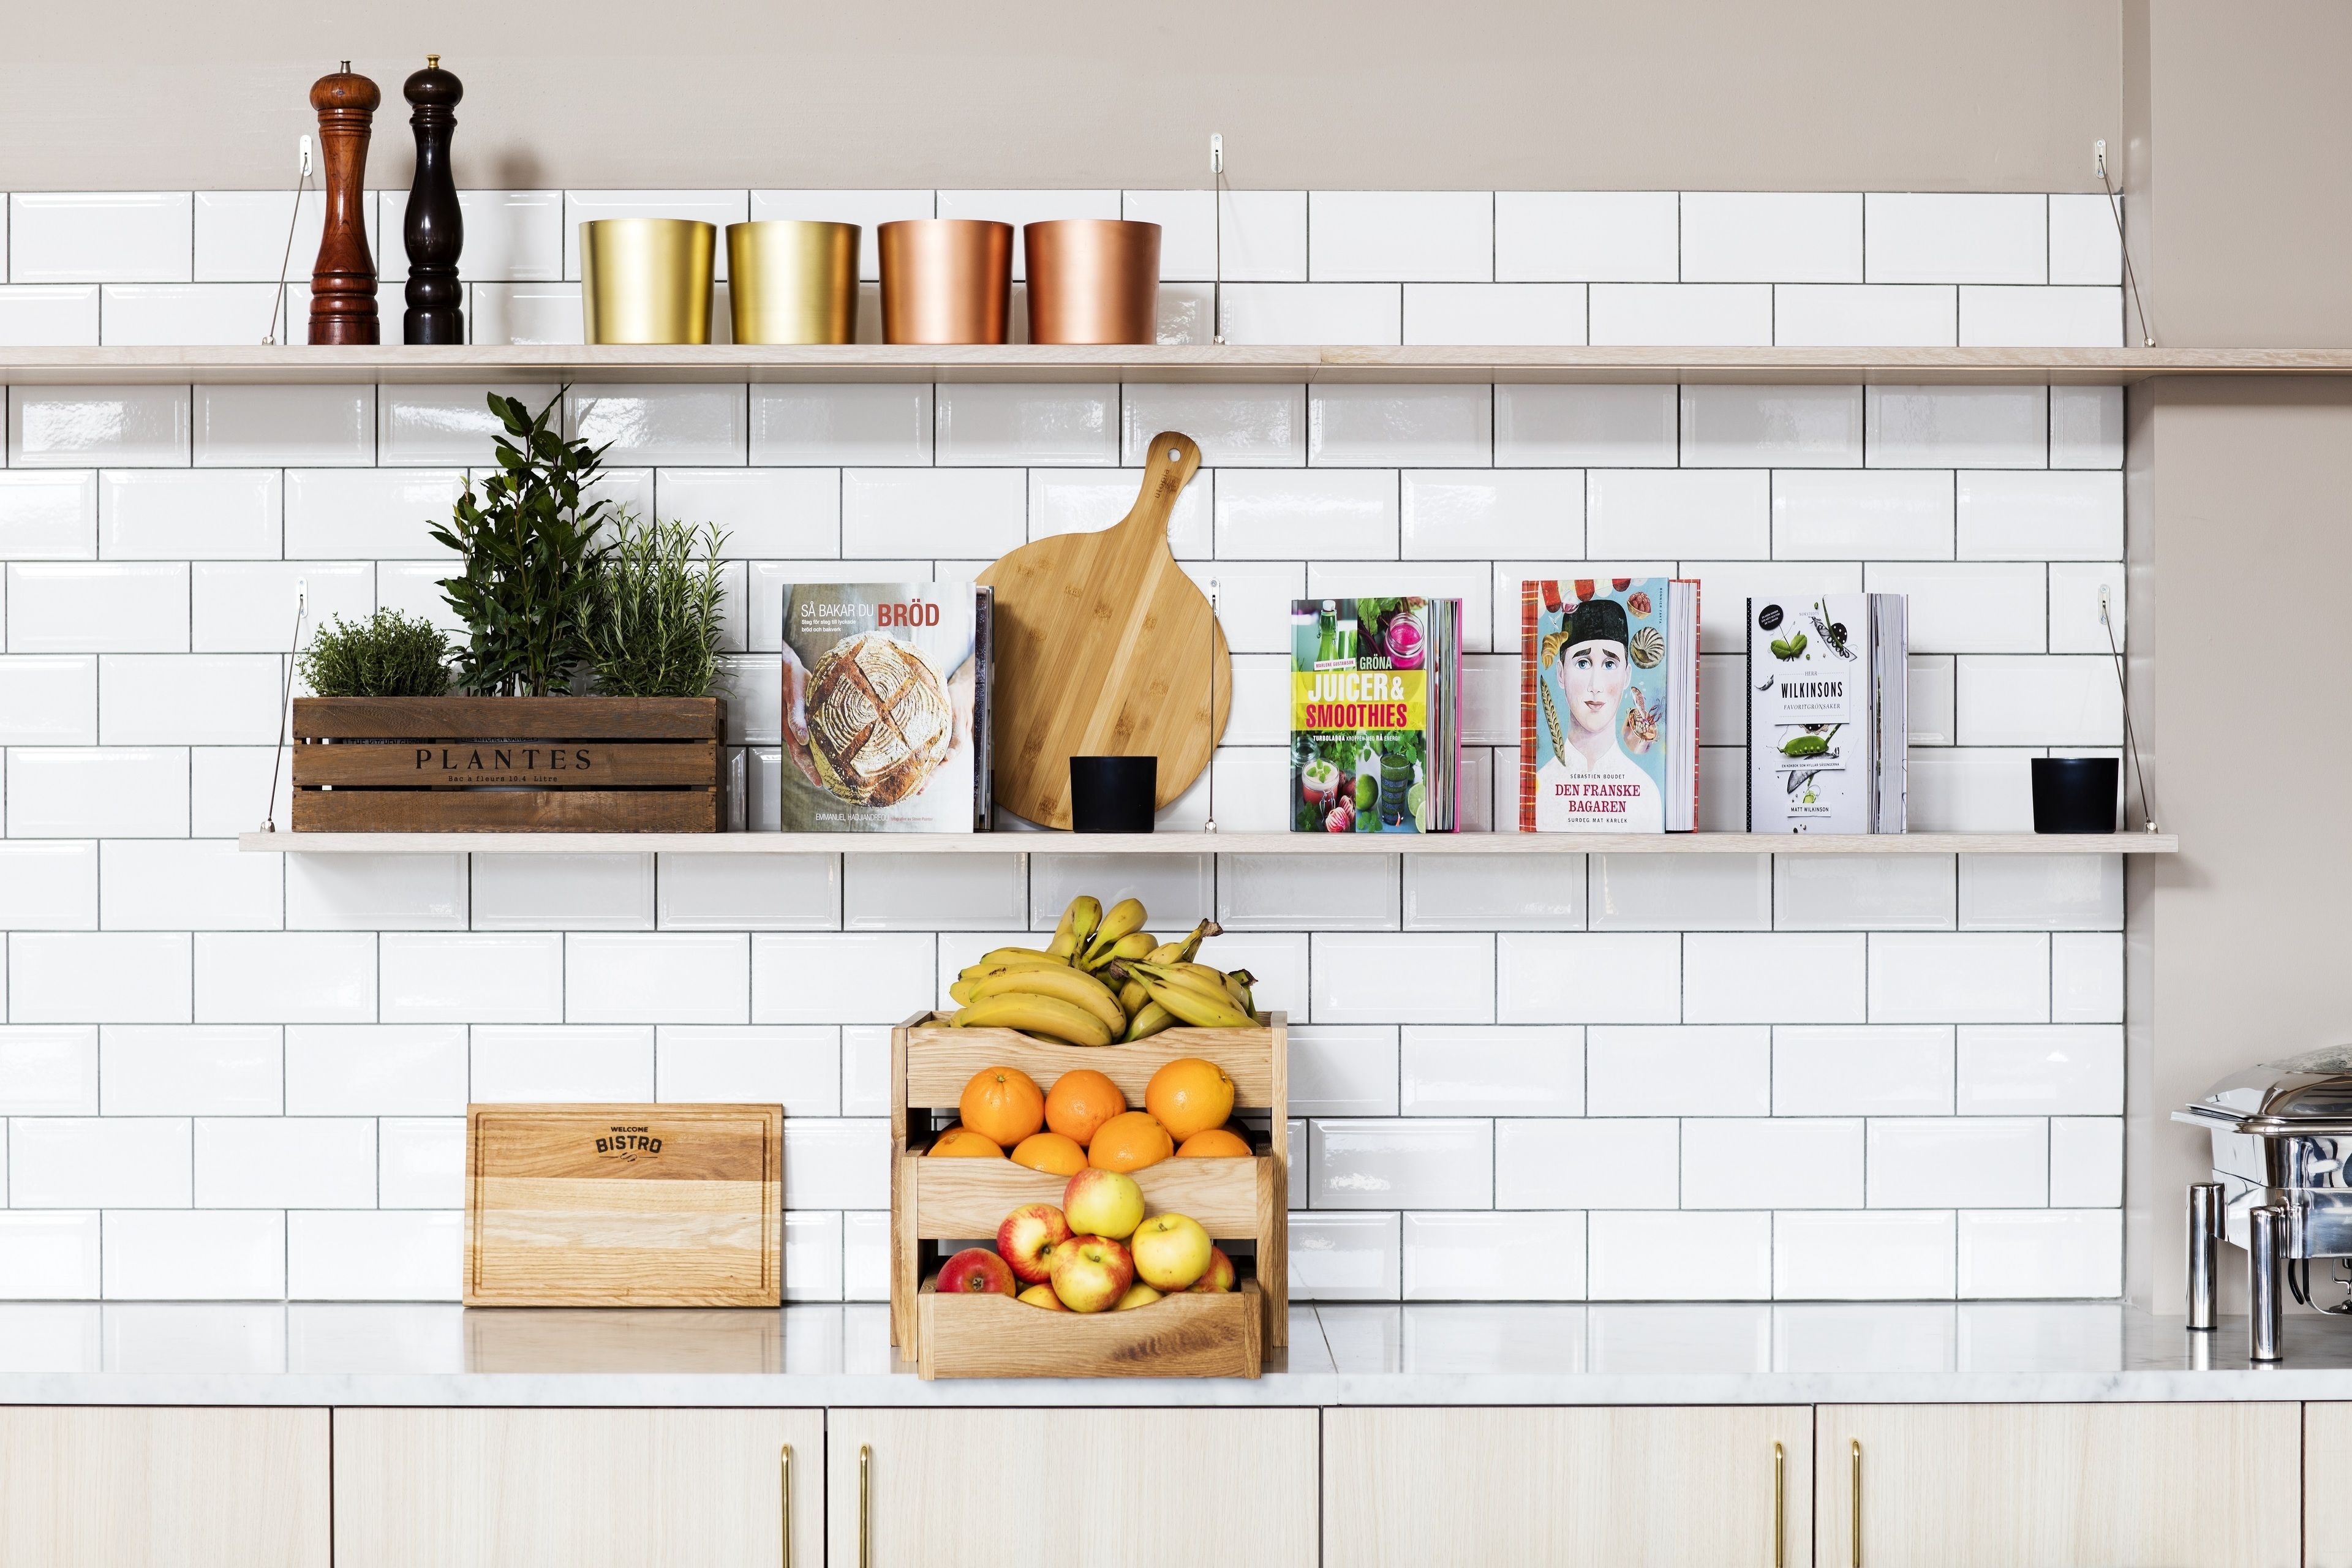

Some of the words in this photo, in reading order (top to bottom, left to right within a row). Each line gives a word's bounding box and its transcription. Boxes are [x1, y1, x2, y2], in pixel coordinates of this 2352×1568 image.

[1155, 469, 1170, 499] utopia
[801, 601, 816, 617] SÅ
[819, 603, 856, 617] BAKAR
[859, 603, 874, 617] DU
[878, 598, 940, 627] BRÖD
[1359, 653, 1393, 670] GRÖNA
[1308, 673, 1389, 702] JUICER
[1390, 676, 1404, 701] &
[1781, 681, 1842, 698] WILKINSONS
[1305, 703, 1408, 728] SMOOTHIES
[416, 748, 592, 770] PLANTES
[1555, 784, 1580, 796] DEN
[1583, 785, 1640, 797] FRANSKE
[1569, 800, 1627, 813] BAGAREN
[595, 1135, 663, 1153] BISTRO
